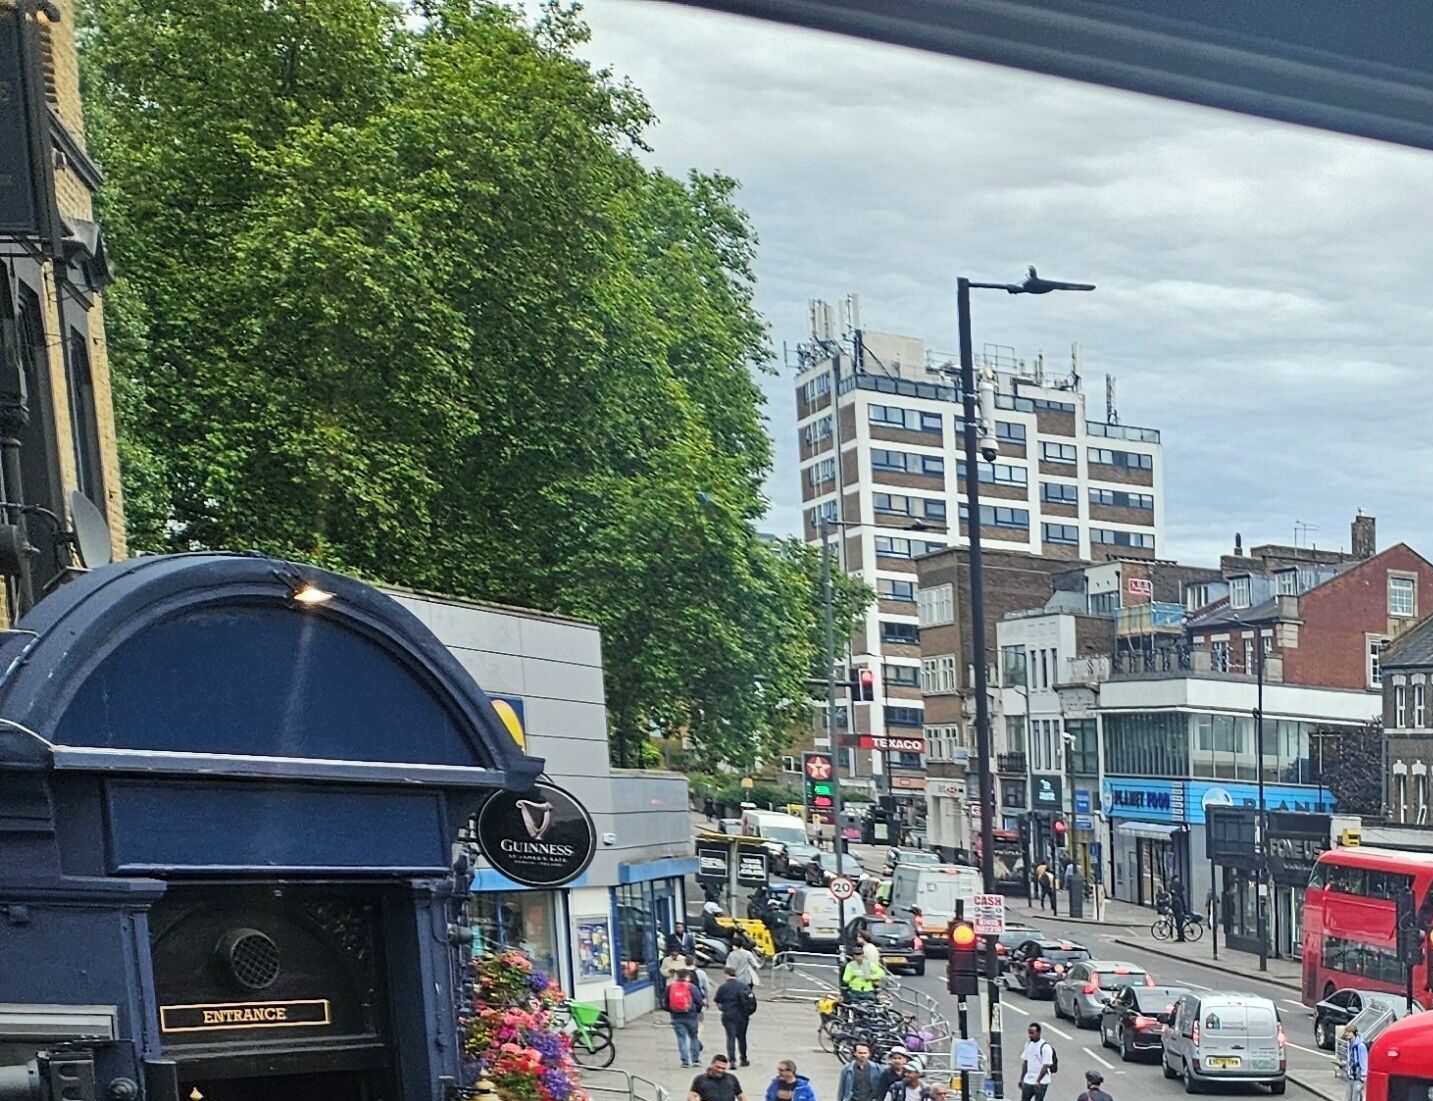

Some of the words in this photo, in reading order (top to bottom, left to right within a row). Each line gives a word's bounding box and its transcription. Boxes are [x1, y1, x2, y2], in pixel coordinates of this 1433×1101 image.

[872, 738, 922, 750] TEXACO
[1114, 789, 1145, 808] PLANET
[1146, 791, 1171, 811] FOOD
[500, 839, 575, 856] GUINNESS
[833, 882, 851, 892] 20
[974, 895, 1002, 906] CASH
[203, 1007, 288, 1023] ENTRANCE
